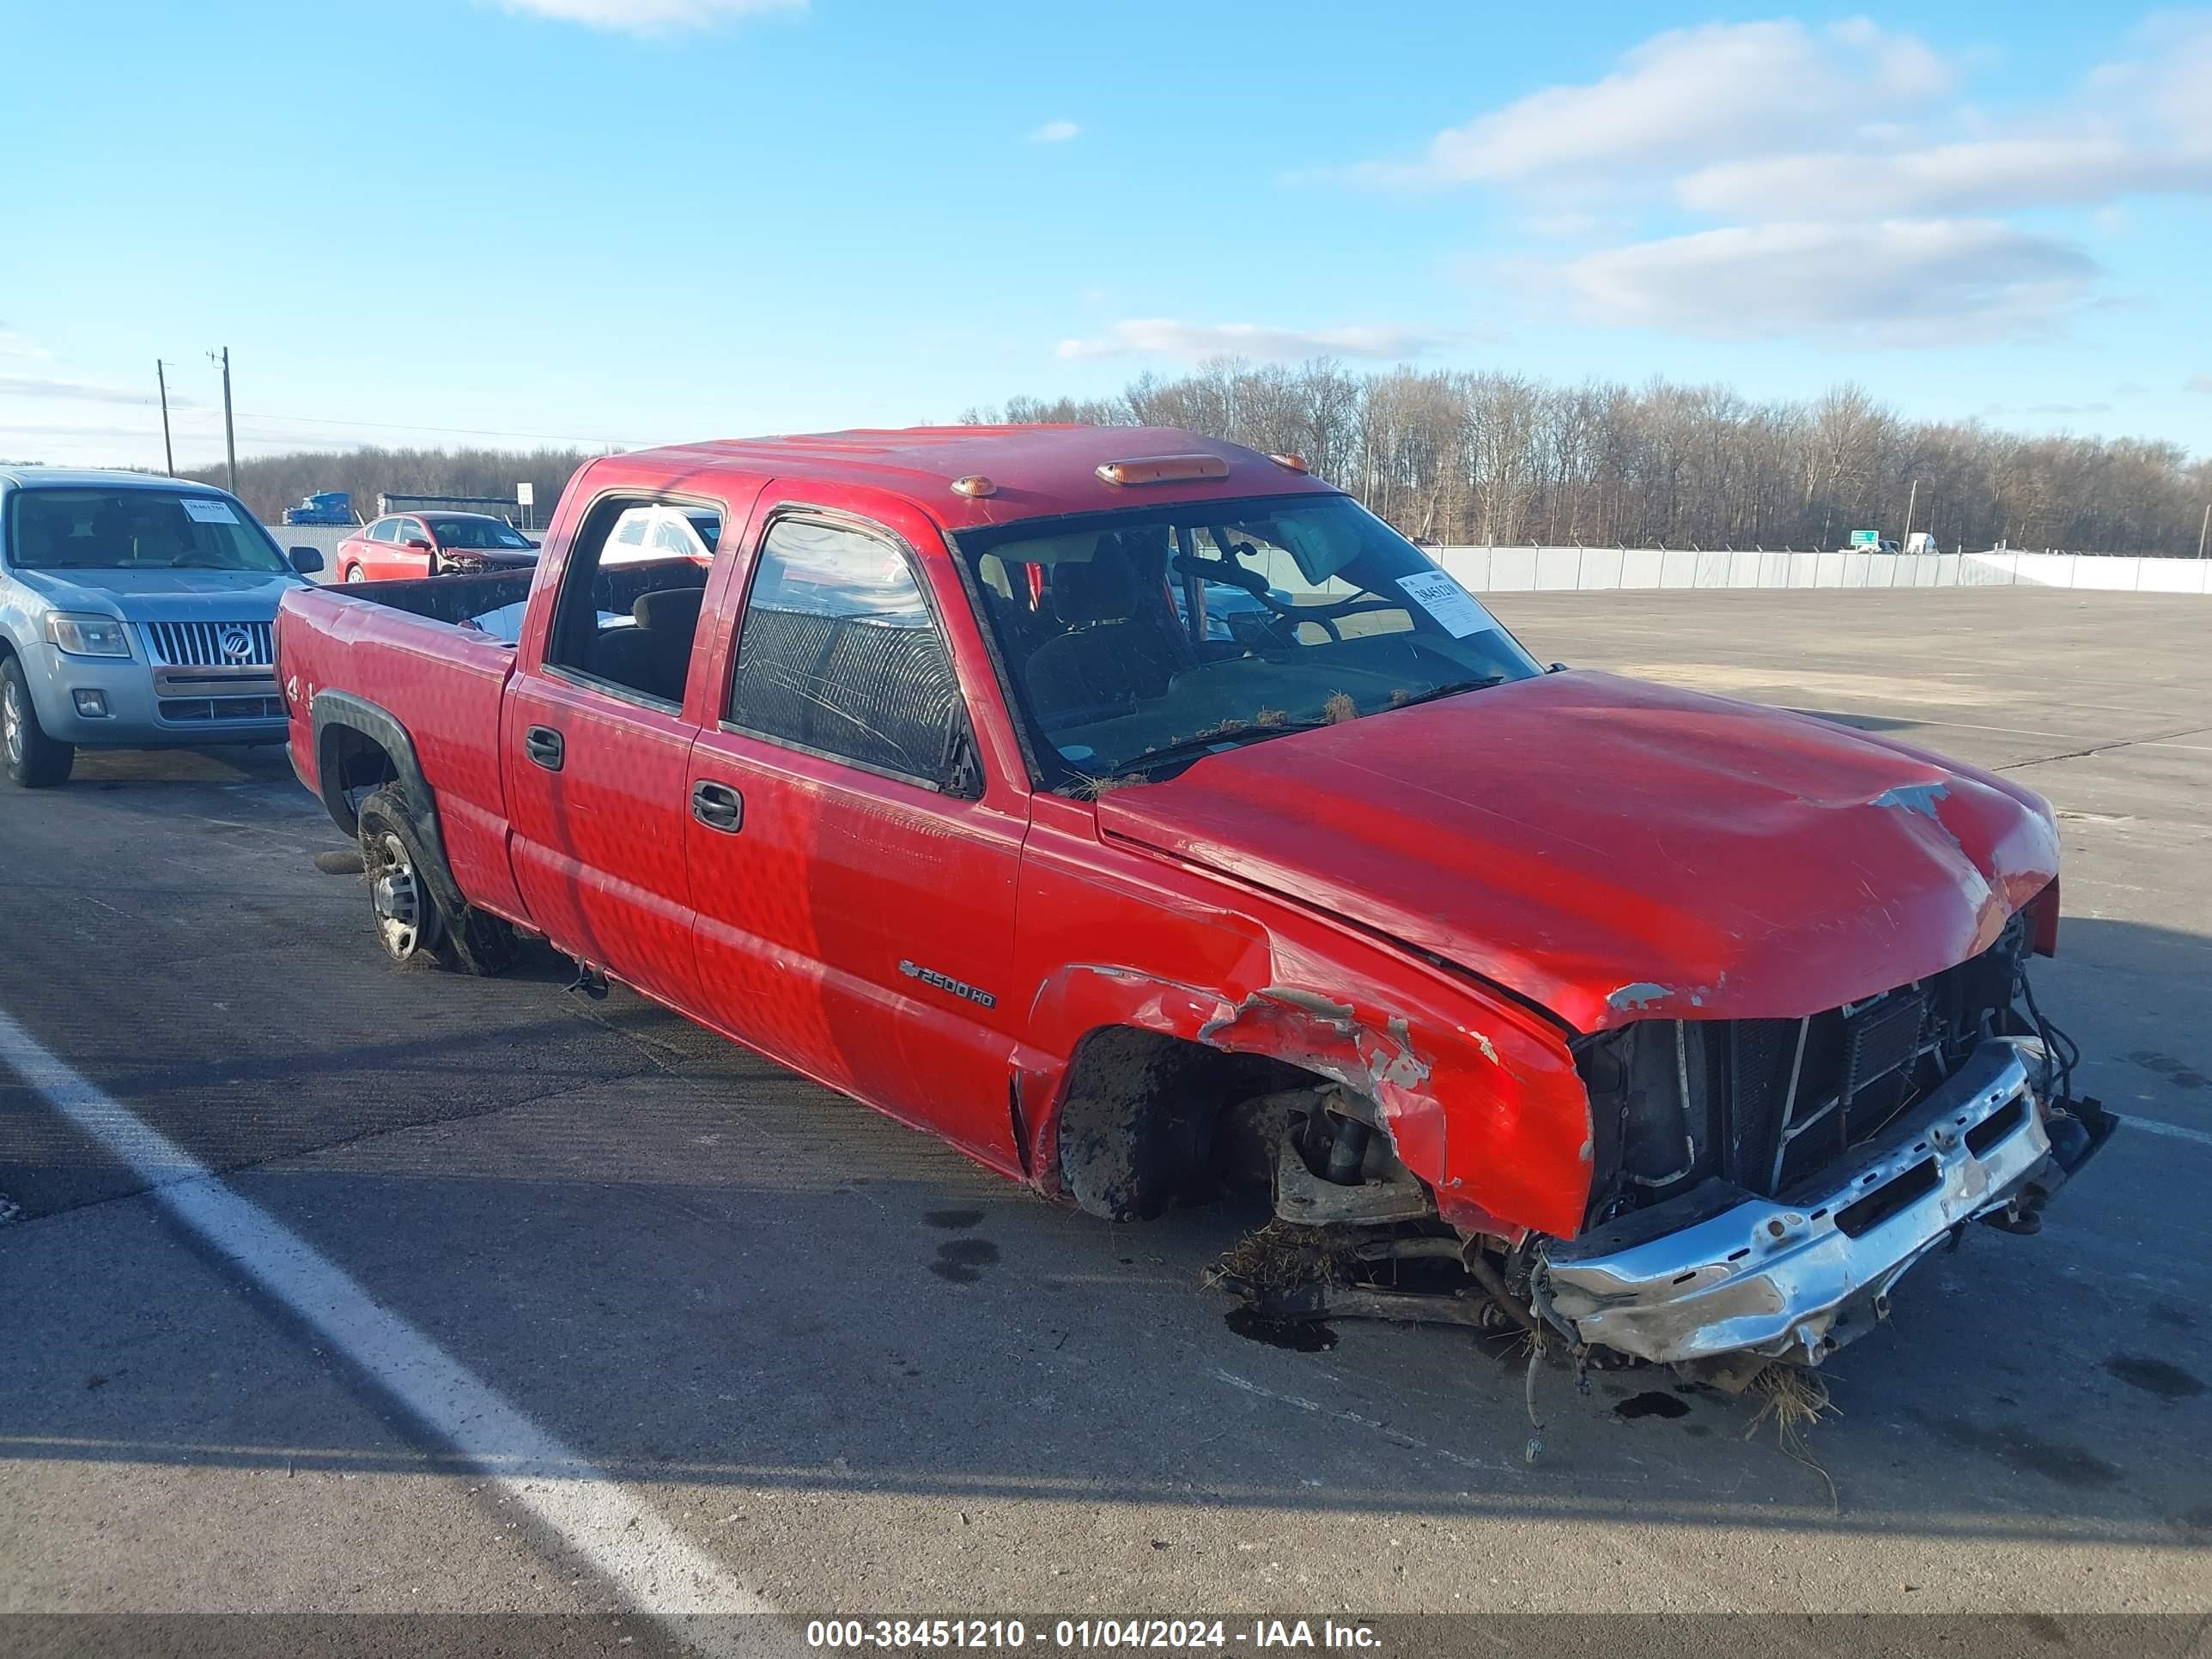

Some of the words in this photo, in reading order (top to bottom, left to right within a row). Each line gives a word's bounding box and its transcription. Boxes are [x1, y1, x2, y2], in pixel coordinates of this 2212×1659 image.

[1414, 583, 1459, 602] 38451210
[921, 969, 969, 998] 2500
[971, 990, 994, 1007] HD
